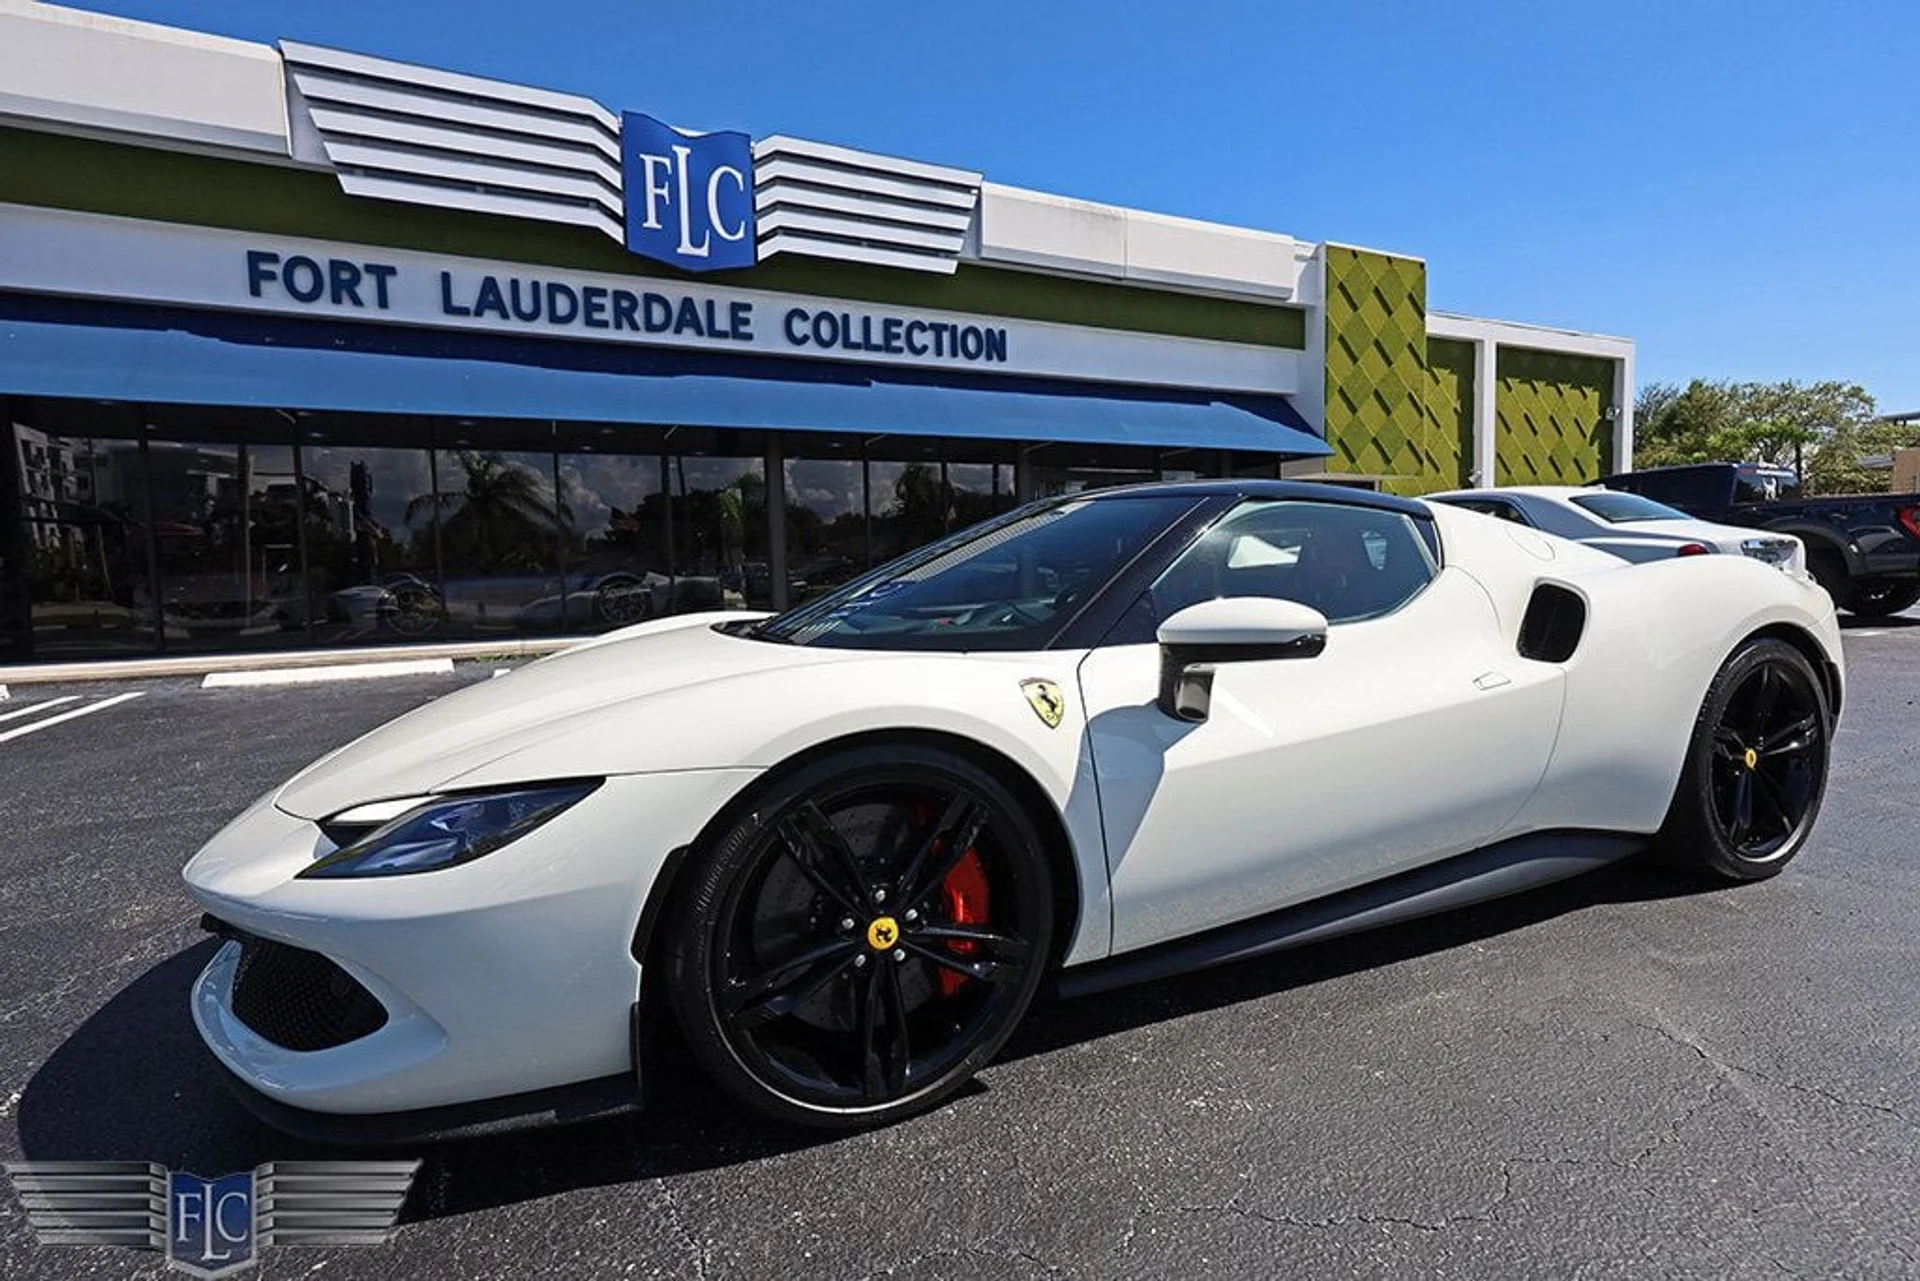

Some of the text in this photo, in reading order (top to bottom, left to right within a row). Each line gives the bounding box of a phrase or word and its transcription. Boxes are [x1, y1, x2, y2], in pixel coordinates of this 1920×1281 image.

[640, 144, 746, 257] FLC
[247, 250, 1007, 361] FORT LAUDERDALE COLLECTION
